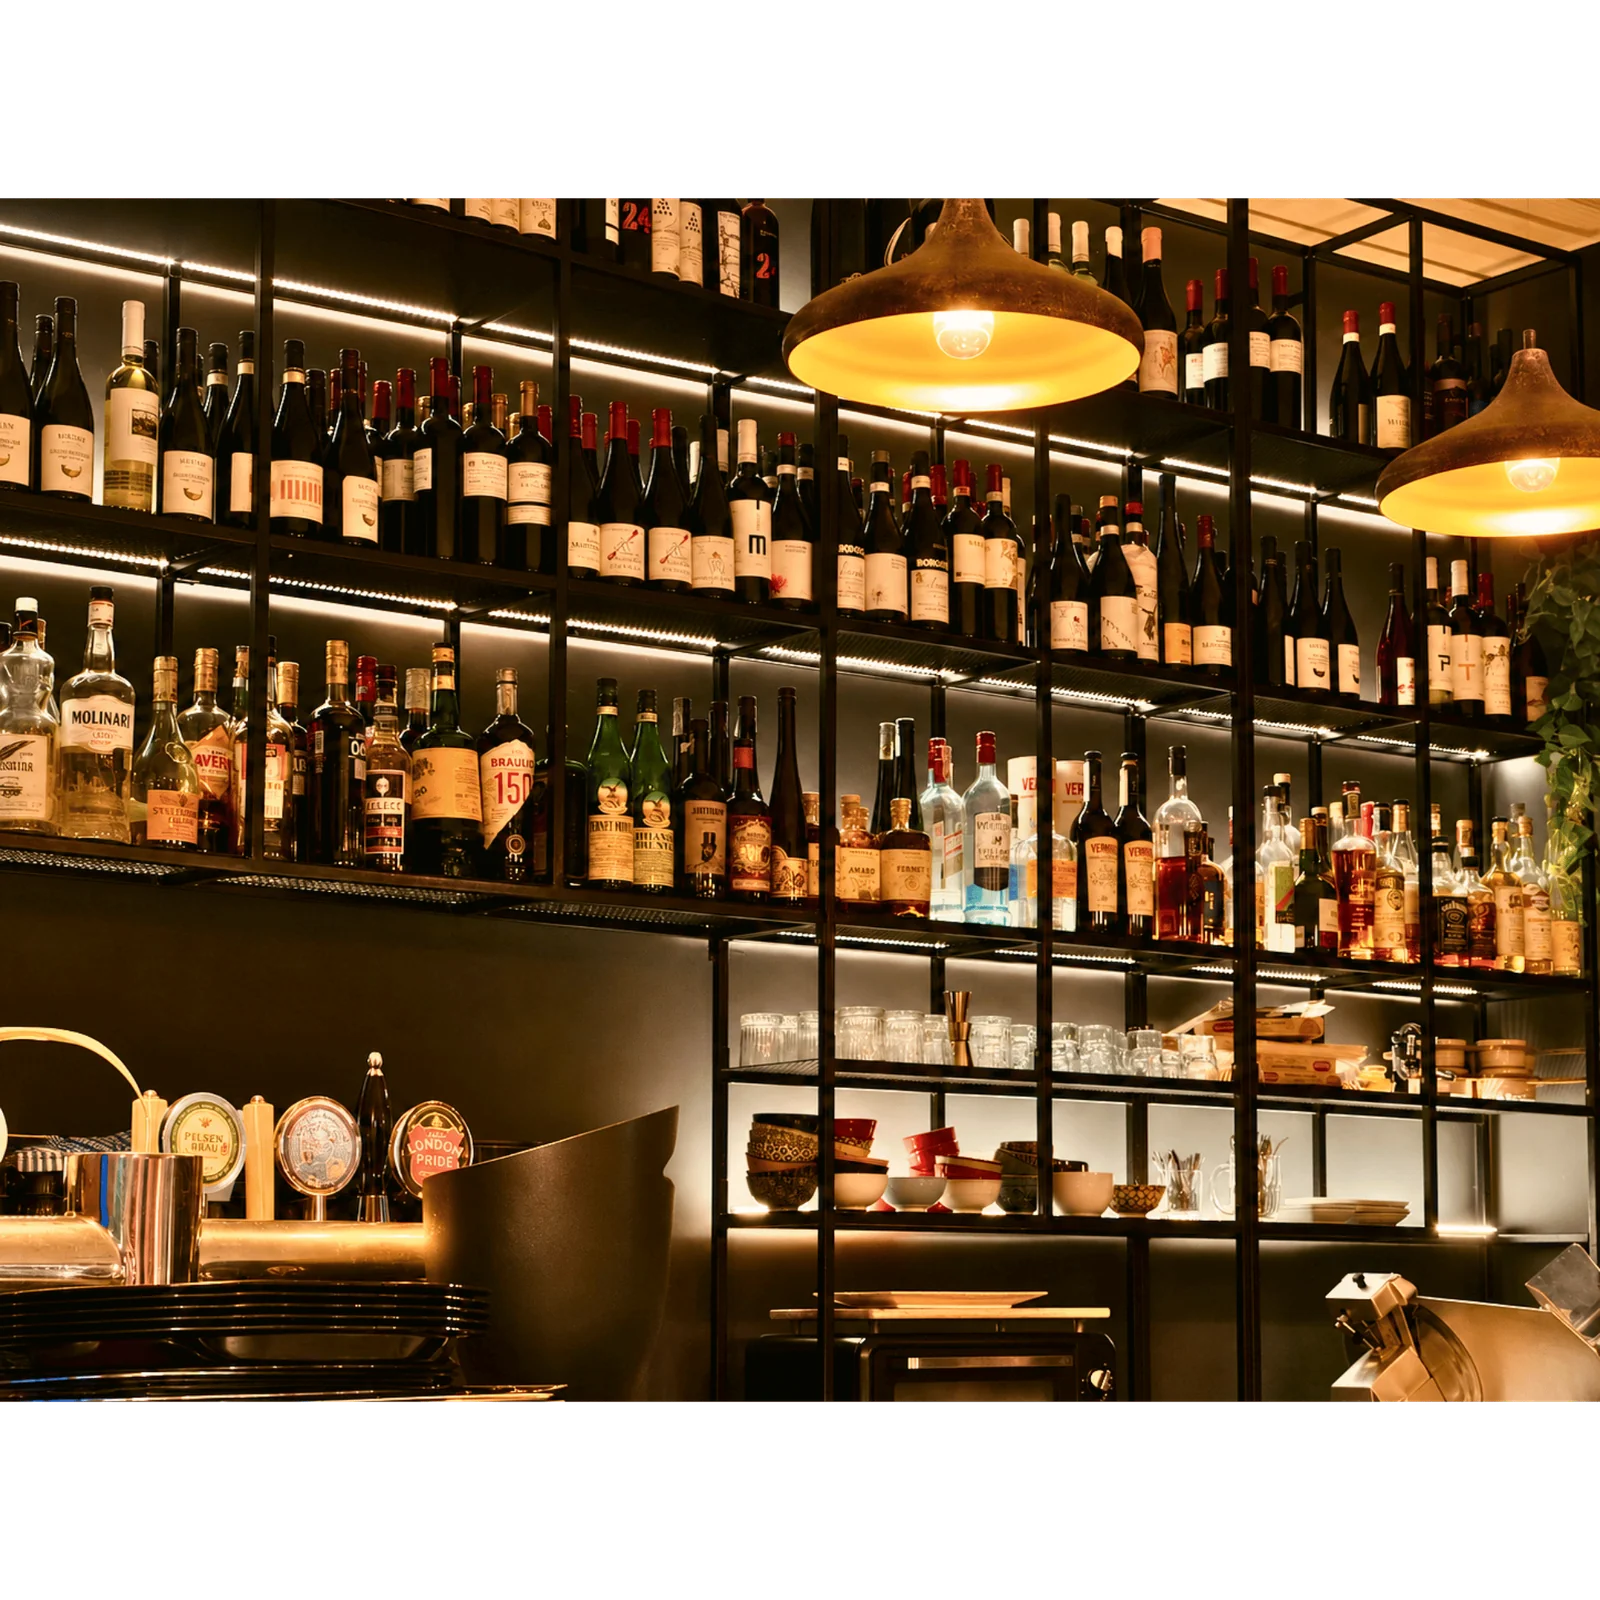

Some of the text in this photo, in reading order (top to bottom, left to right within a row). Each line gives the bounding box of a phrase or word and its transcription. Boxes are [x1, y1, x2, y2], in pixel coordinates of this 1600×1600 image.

[1458, 664, 1476, 681] T
[71, 710, 130, 729] MOLINARI
[407, 1138, 464, 1158] LONDON
[416, 1154, 453, 1168] PRIDE
